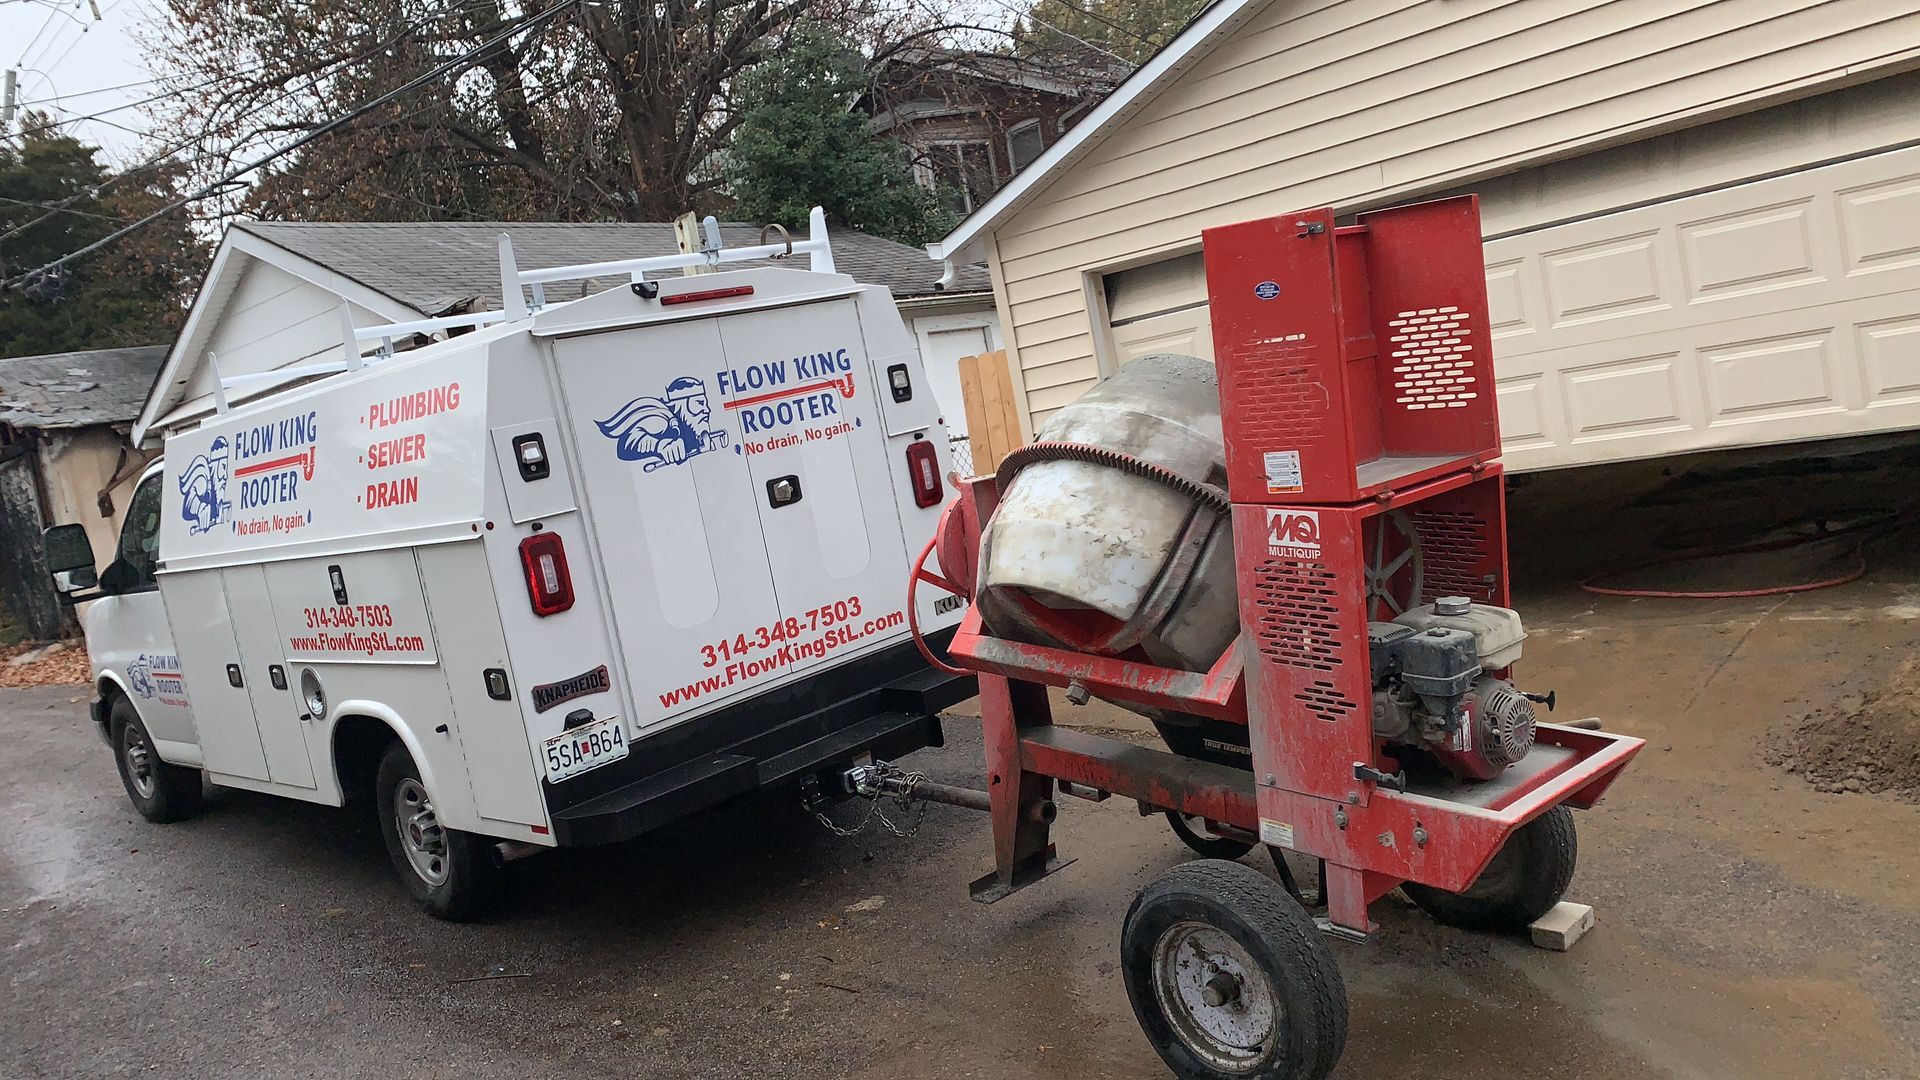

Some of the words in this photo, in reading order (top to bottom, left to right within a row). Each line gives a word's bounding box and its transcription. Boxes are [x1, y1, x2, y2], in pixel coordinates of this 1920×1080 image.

[716, 360, 786, 396] FLOW
[793, 348, 852, 380] KING
[369, 382, 460, 430] PLUMBING
[741, 393, 838, 434] ROOTER
[235, 423, 275, 461] FLOW
[279, 411, 317, 450] KING
[367, 433, 426, 470] SEWER
[744, 443, 764, 456] No
[766, 433, 804, 451] drain,
[804, 429, 822, 441] No
[825, 421, 854, 440] gain.
[241, 470, 298, 510] ROOTER
[366, 476, 418, 510] DRAIN
[237, 520, 248, 536] No
[248, 516, 271, 535] drain,
[272, 515, 284, 531] No
[285, 510, 305, 534] gain.
[1268, 546, 1321, 560] MULTIQUIP
[304, 604, 393, 629] 314-348-7503
[700, 596, 862, 668] 314-348-7503
[290, 631, 425, 656] www.FlowKingStL.com
[659, 610, 905, 709] www.FlowKingStL.com
[156, 679, 184, 694] ROOTER
[536, 668, 607, 707] KNAPHEIDE
[547, 740, 584, 771] 5SA
[589, 725, 623, 758] B64
